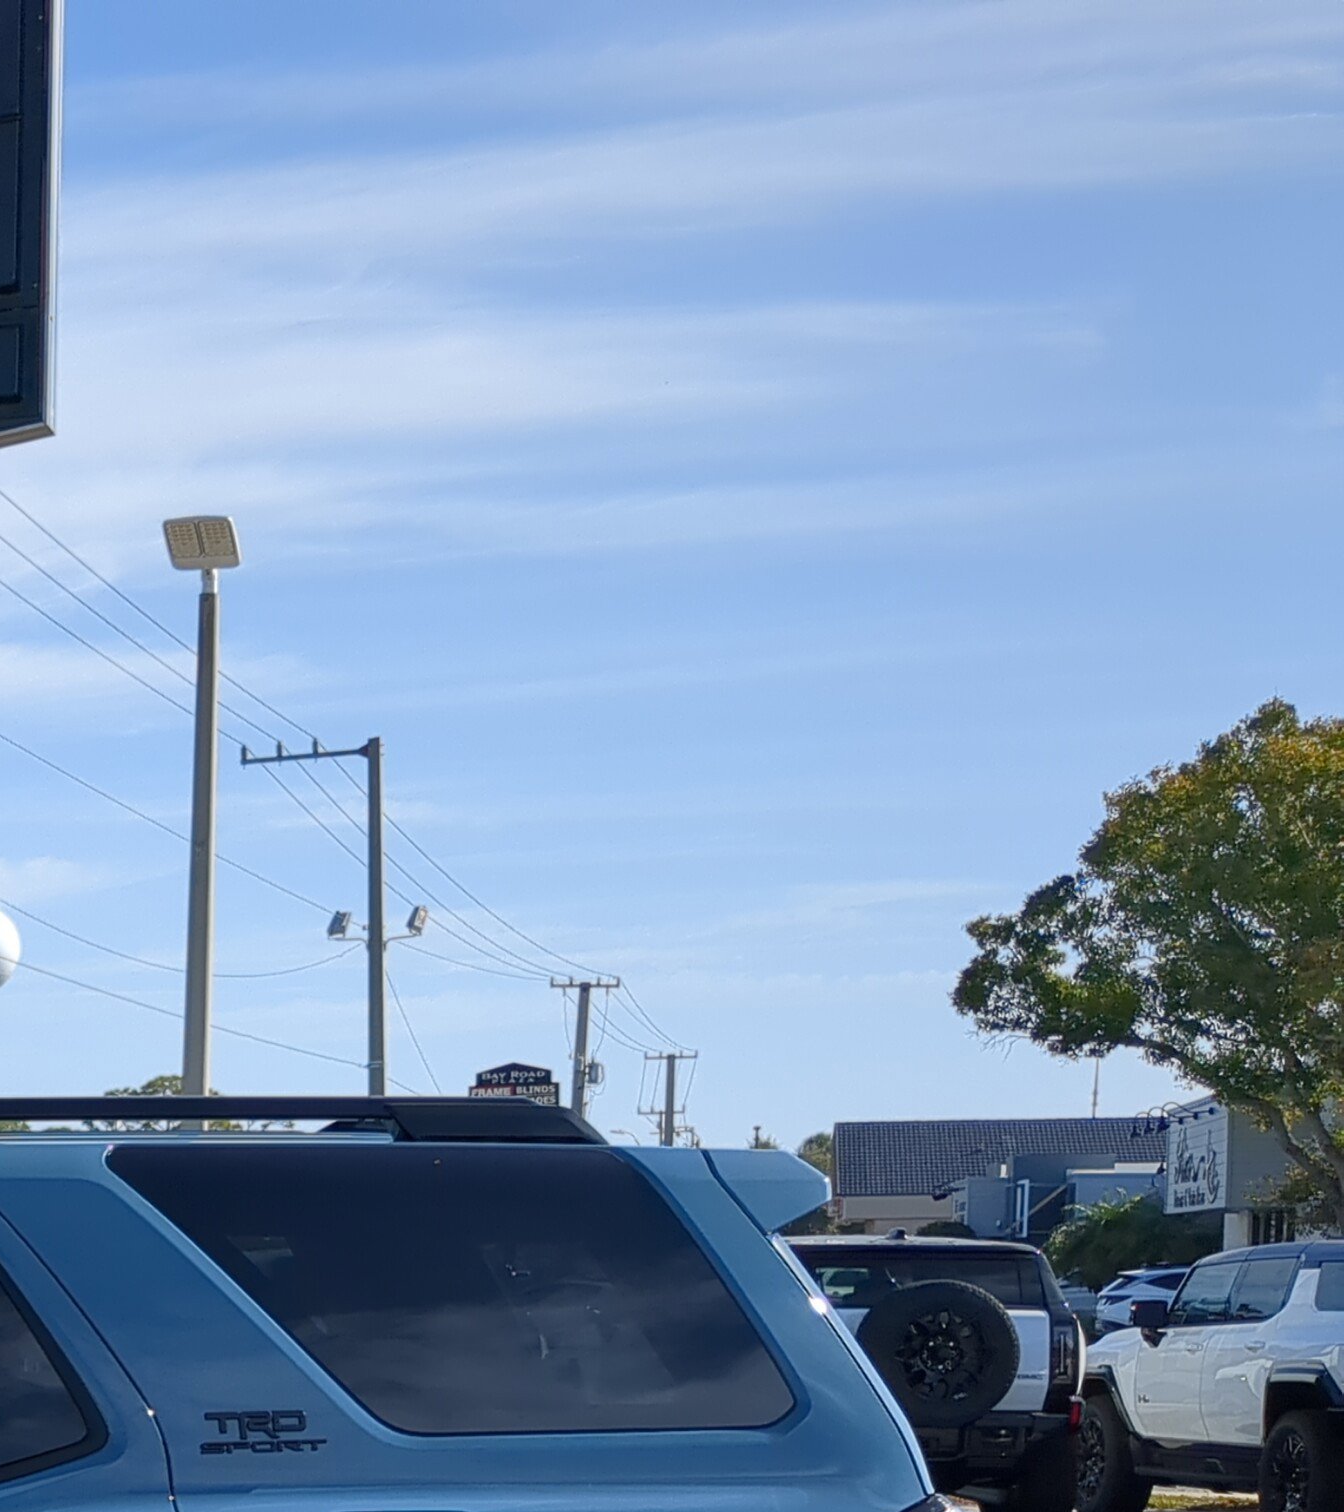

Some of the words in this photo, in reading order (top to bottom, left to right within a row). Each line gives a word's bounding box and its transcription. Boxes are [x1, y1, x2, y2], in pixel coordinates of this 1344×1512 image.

[481, 1073, 507, 1081] BAY
[510, 1070, 546, 1079] ROAD
[472, 1086, 512, 1097] FRAME
[516, 1085, 556, 1095] BLINDS
[203, 1410, 308, 1440] TRD
[199, 1439, 328, 1455] SPORT
